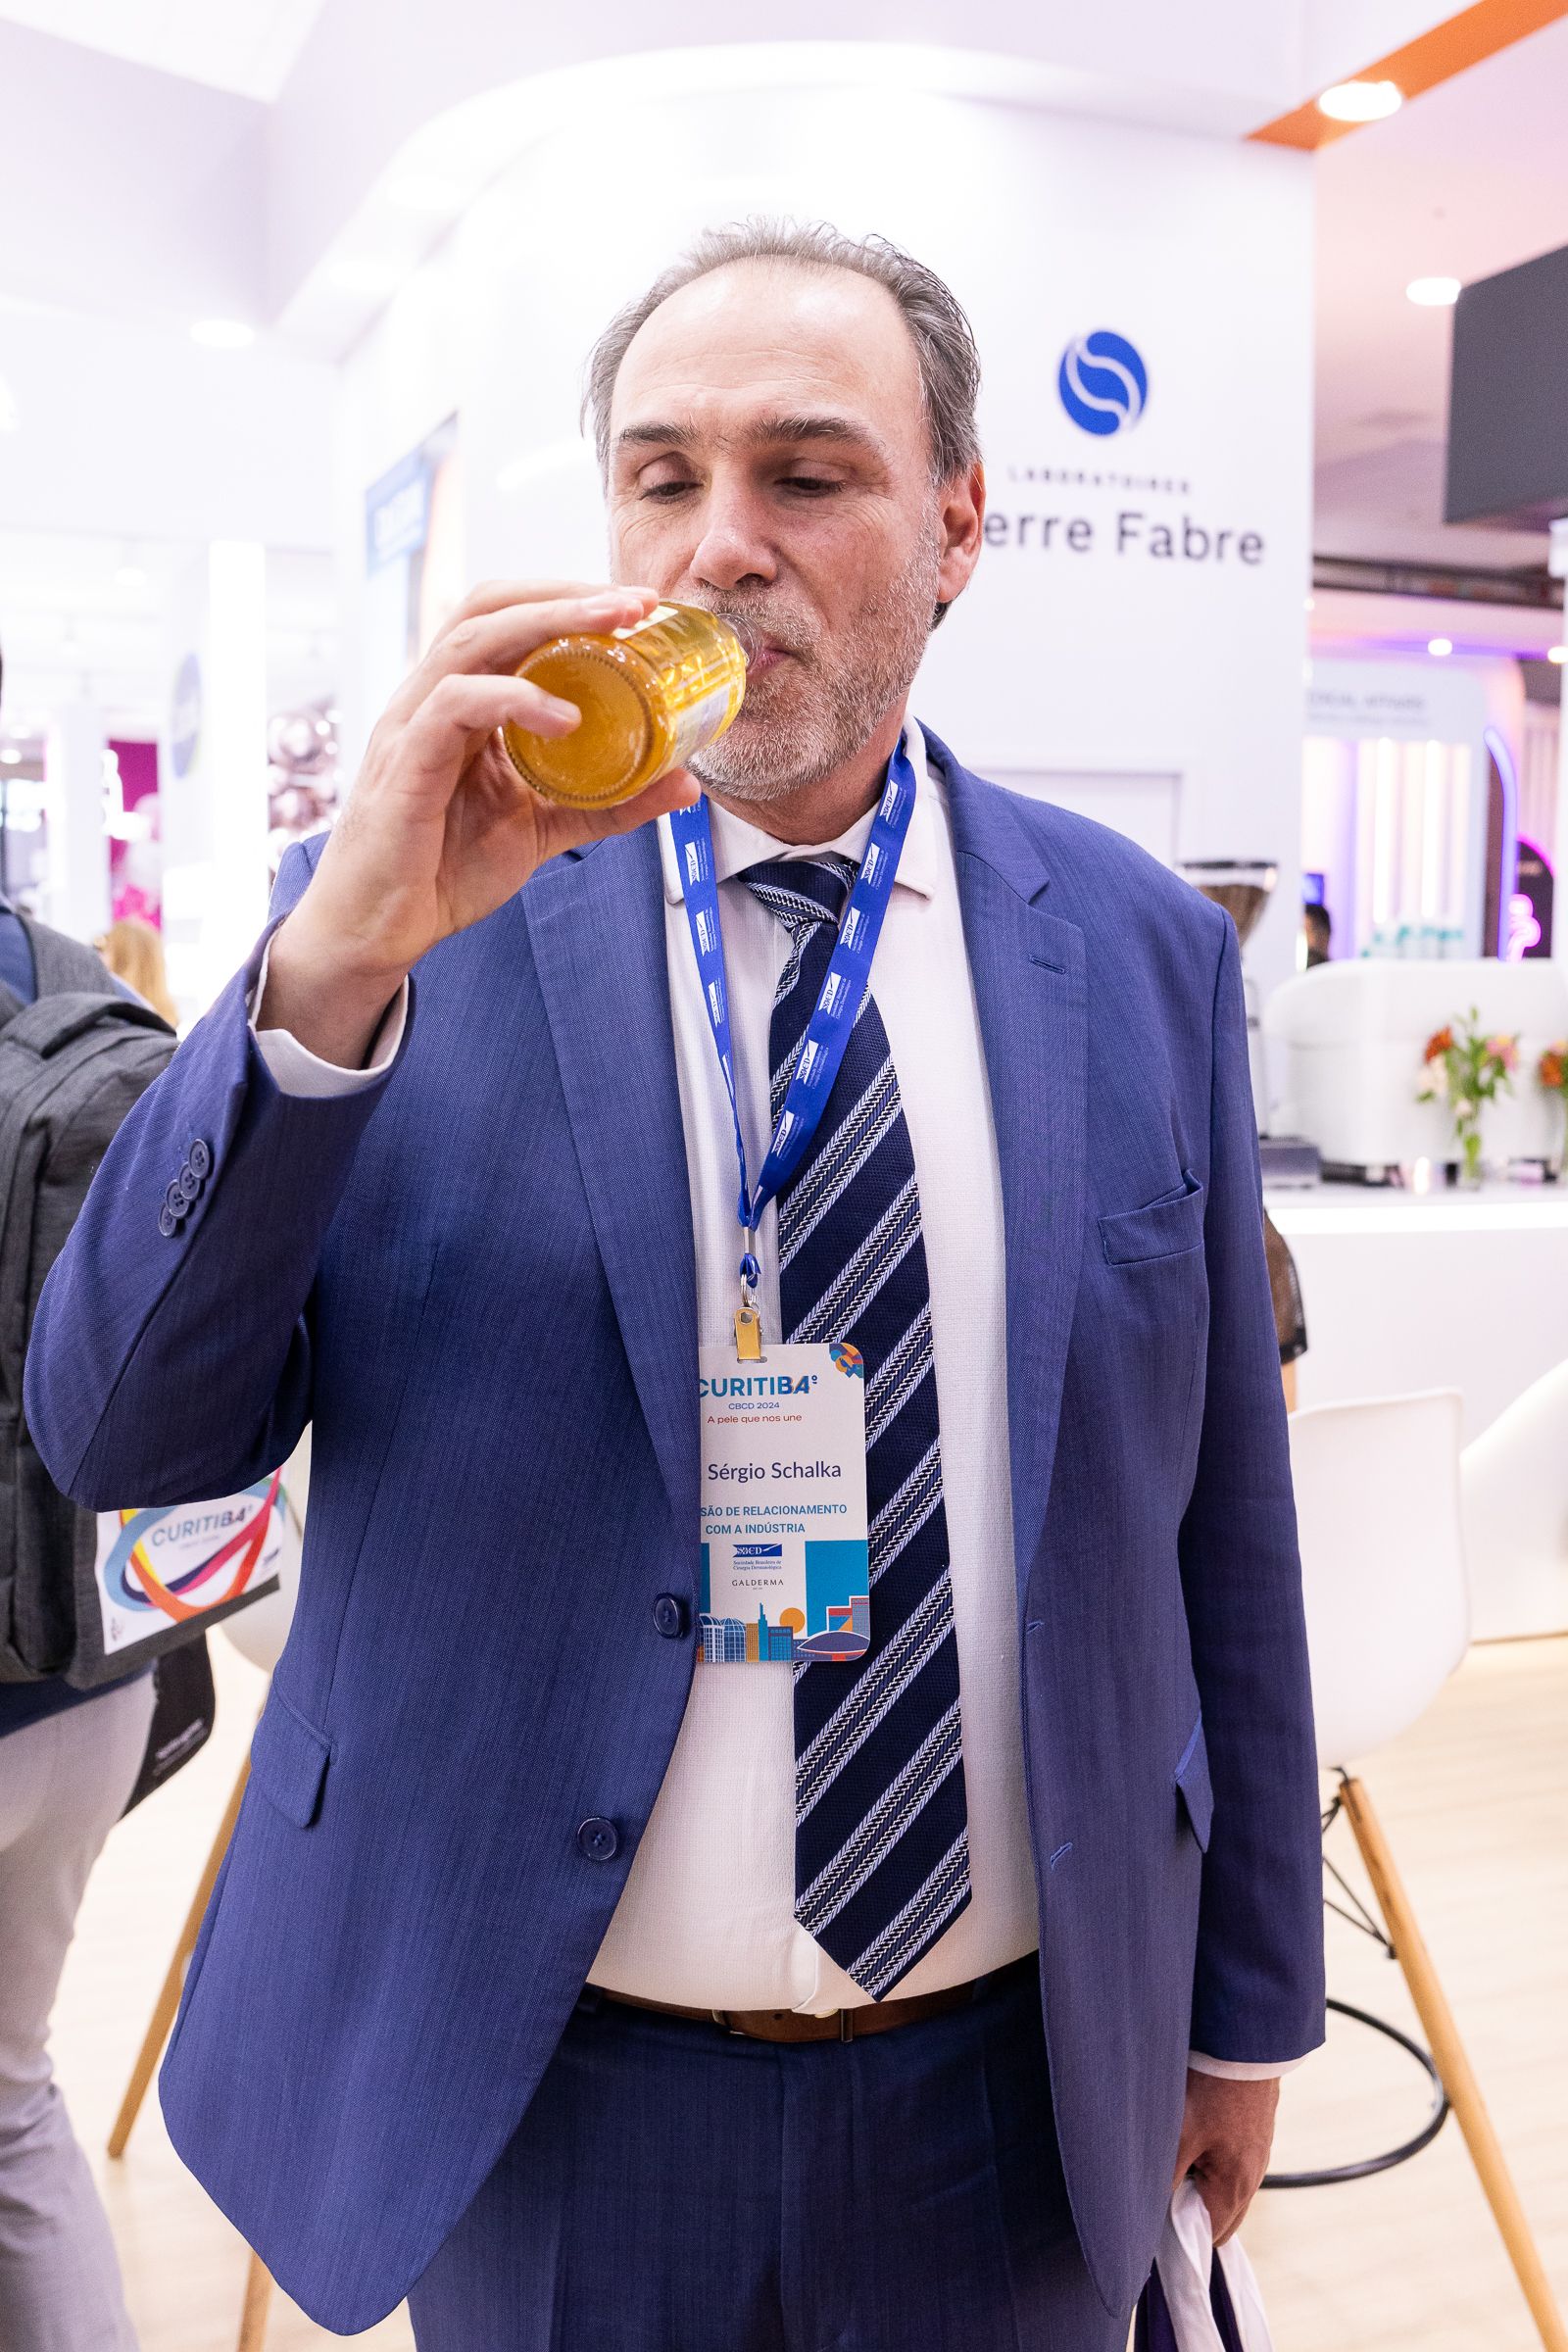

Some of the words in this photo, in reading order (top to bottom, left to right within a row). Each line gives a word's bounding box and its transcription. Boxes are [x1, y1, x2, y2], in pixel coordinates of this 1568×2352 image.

[984, 512, 1093, 553] erre
[1117, 511, 1265, 565] Fabre
[708, 1462, 765, 1483] Sérgio
[771, 1460, 841, 1479] Schalka
[726, 1506, 740, 1516] DE
[743, 1503, 847, 1516] RELACIONAMENTO
[706, 1525, 731, 1535] COM
[735, 1525, 742, 1534] A
[746, 1522, 806, 1534] INDÚSTRIA
